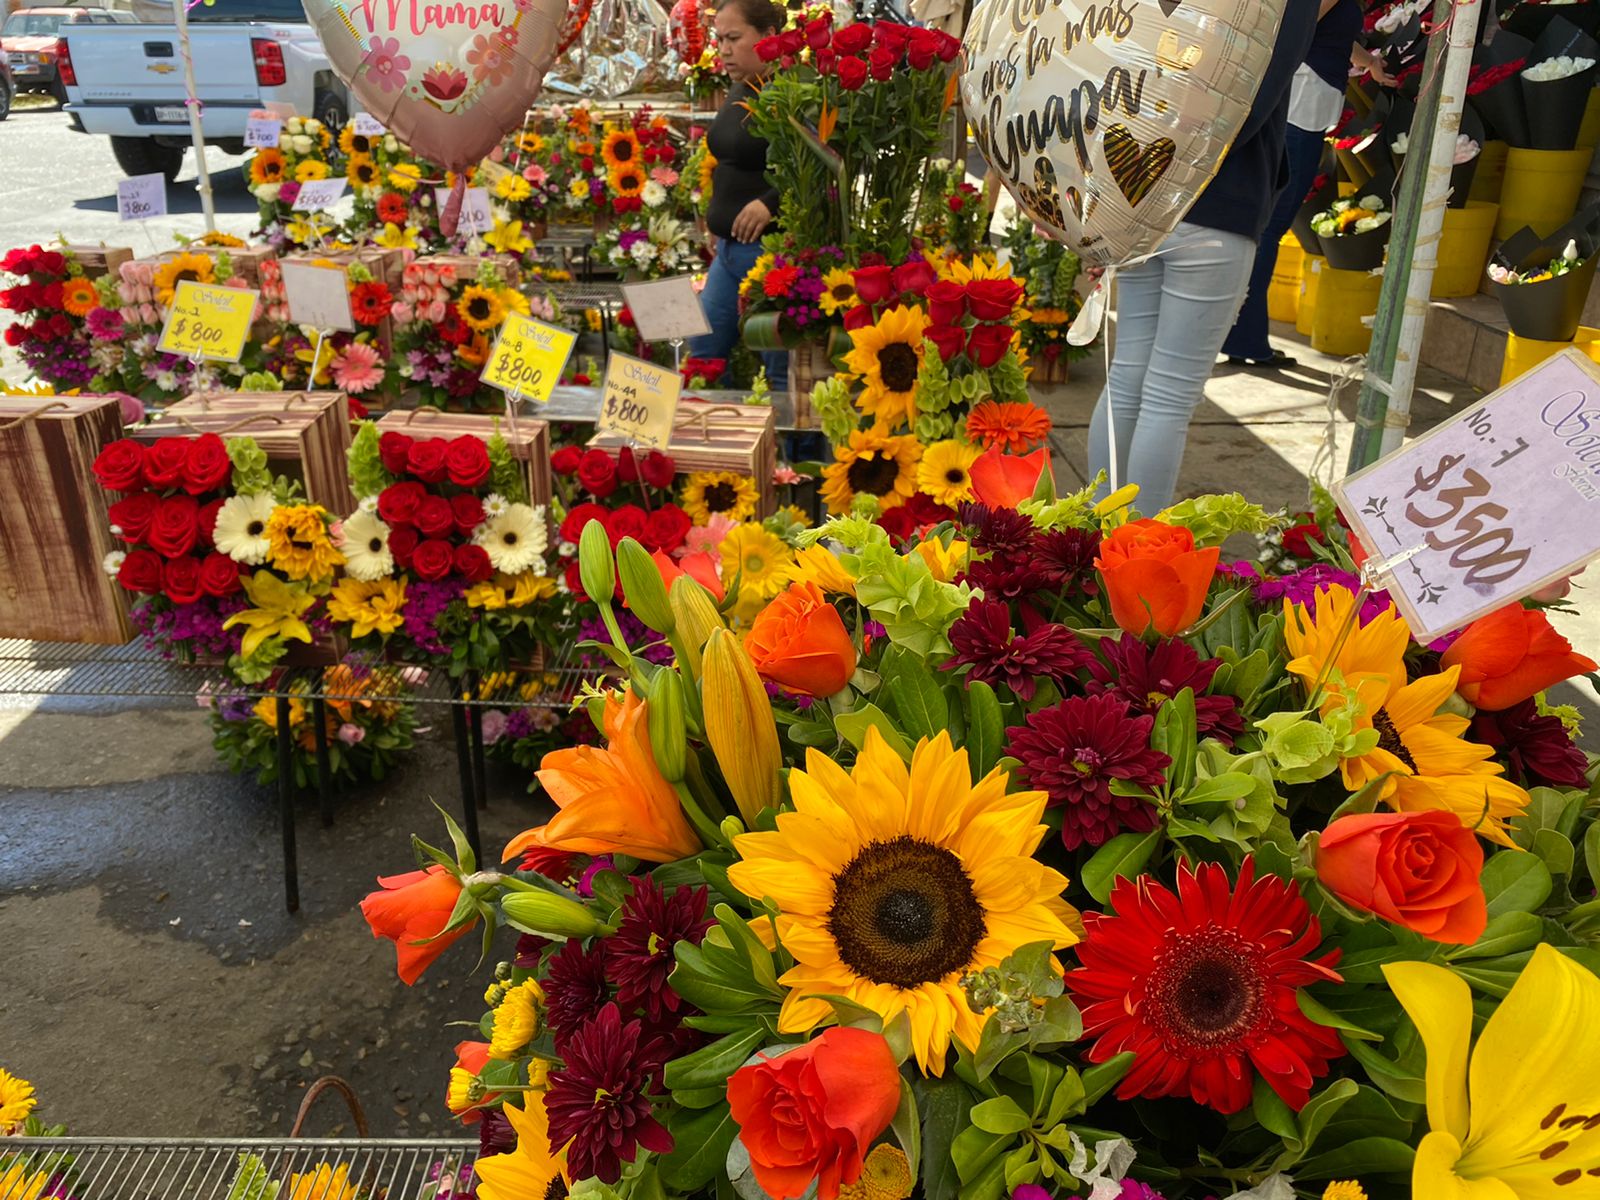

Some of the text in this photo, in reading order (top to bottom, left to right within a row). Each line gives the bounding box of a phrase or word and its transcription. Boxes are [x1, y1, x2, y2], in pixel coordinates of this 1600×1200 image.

[981, 0, 1139, 99] eres la más
[496, 353, 542, 385] $800
[604, 395, 648, 425] $800
[1404, 454, 1532, 586] $3500
